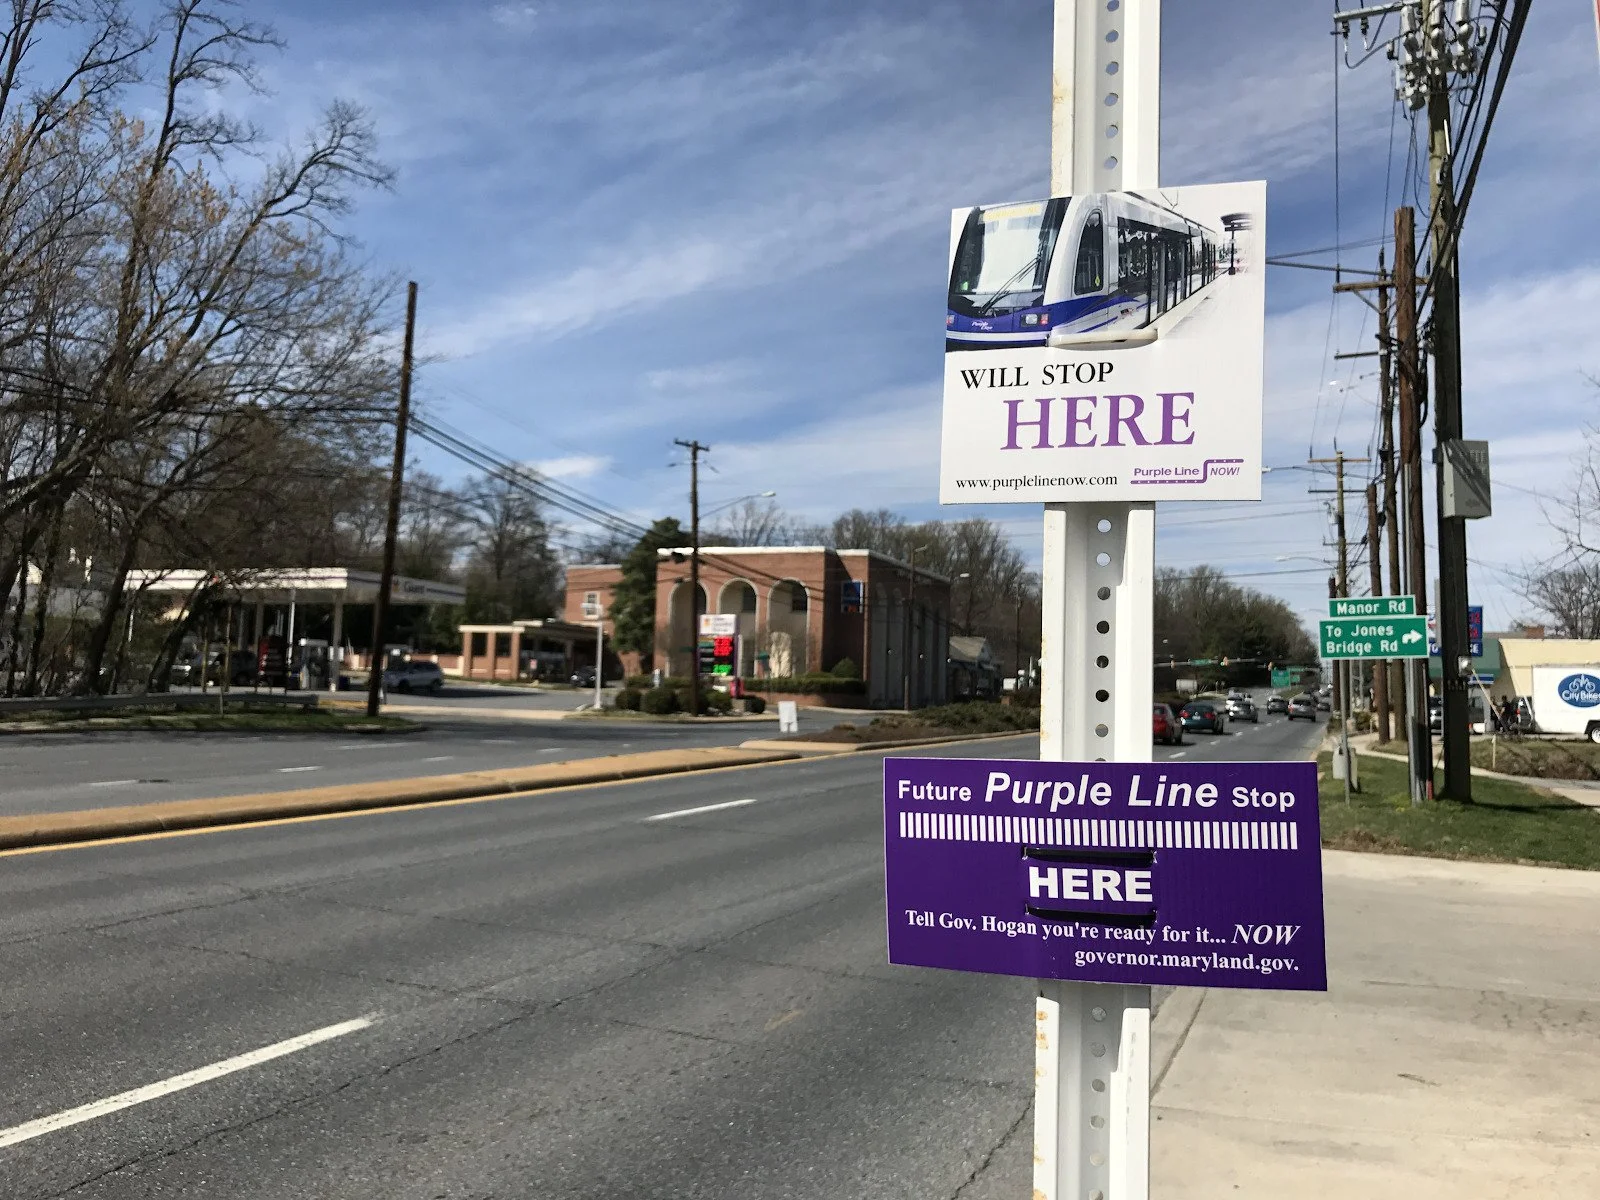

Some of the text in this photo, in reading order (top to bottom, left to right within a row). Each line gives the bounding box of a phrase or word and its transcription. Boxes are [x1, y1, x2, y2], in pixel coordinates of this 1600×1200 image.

[960, 362, 1114, 389] WILL STOP
[1000, 391, 1195, 450] HERE
[956, 475, 1118, 491] www.purplelinenow.com
[1134, 466, 1240, 477] Purple Line NOW!
[1336, 599, 1407, 614] Manor Rd
[1325, 624, 1394, 637] To Jones
[1325, 639, 1398, 655] Bridge Rd
[898, 772, 1296, 812] Future Purple Line Stop
[1029, 867, 1153, 902] HERE
[905, 909, 1301, 946] Tell Gov. Hogan you're ready for it... NOW
[1074, 949, 1300, 975] governor.maryland.gov.
